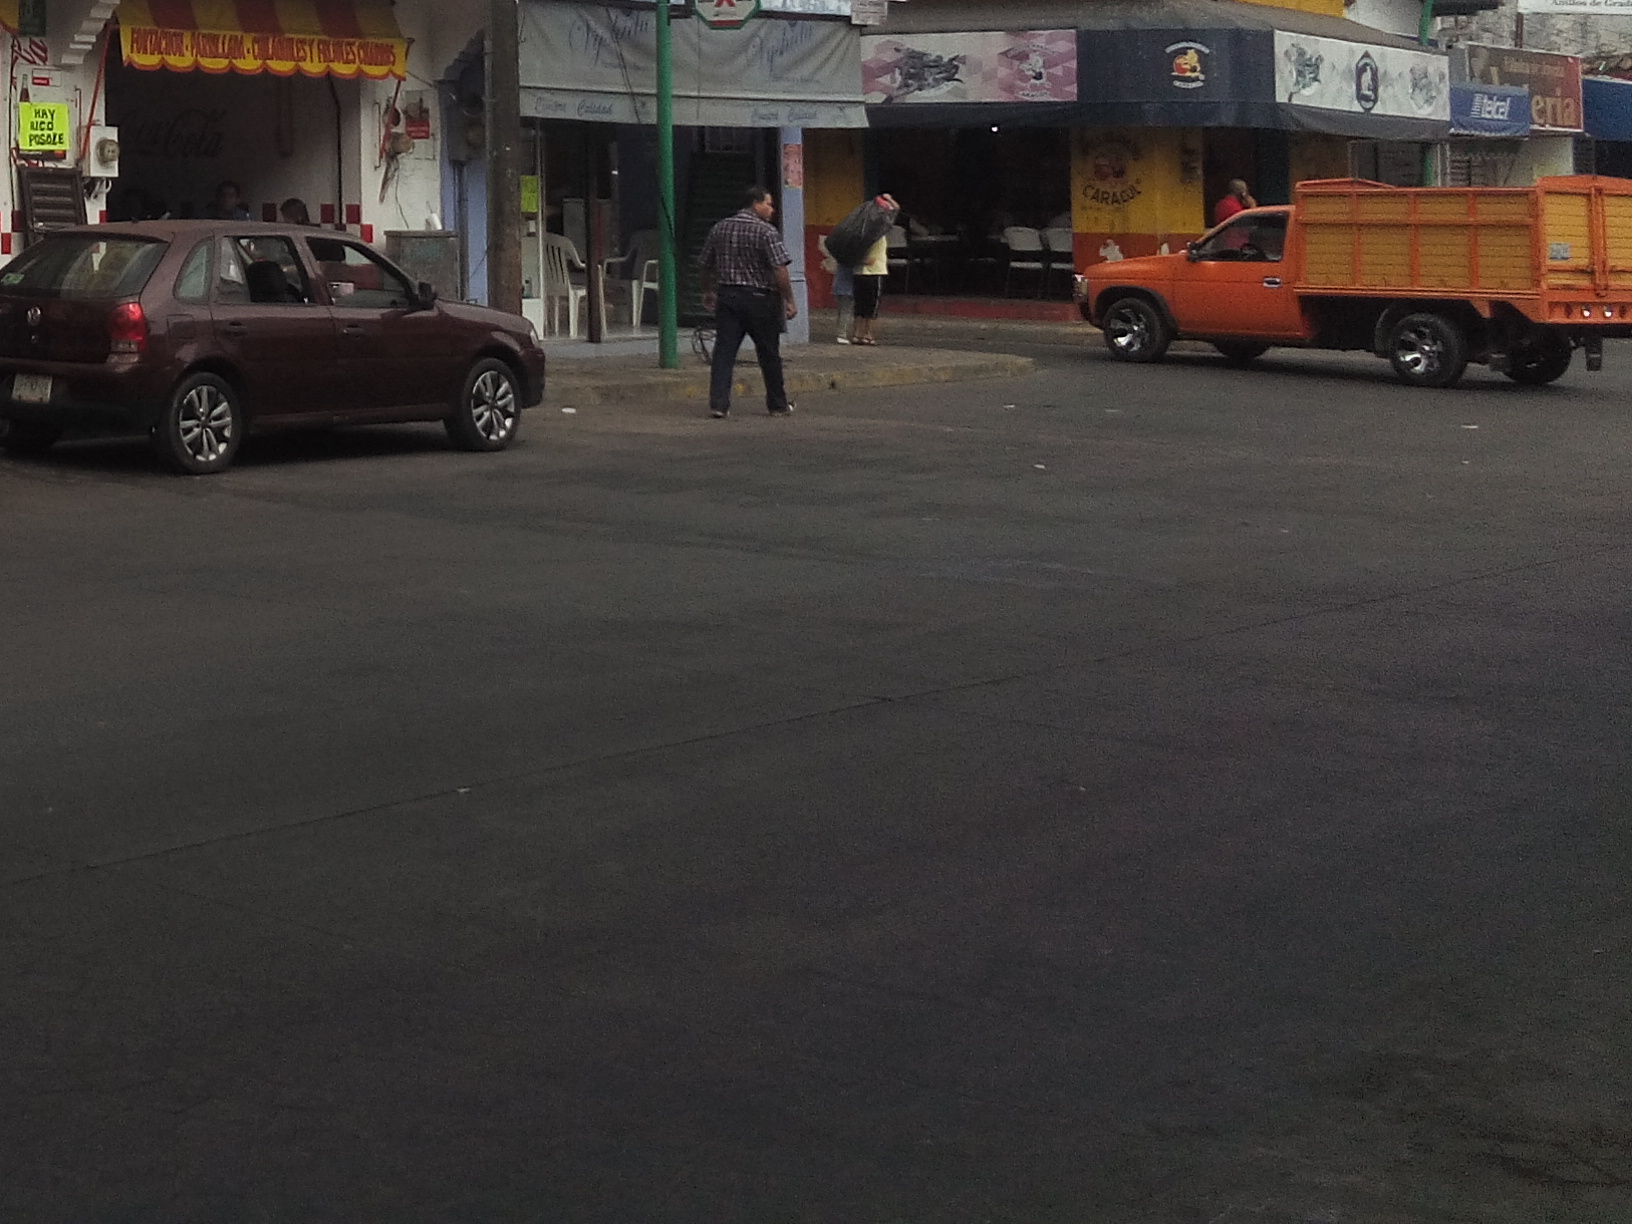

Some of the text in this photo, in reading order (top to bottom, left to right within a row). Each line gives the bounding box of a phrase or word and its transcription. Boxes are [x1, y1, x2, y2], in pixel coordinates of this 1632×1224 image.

[1481, 93, 1511, 121] telcel
[34, 109, 55, 122] HAY
[29, 132, 64, 147] POSOLE
